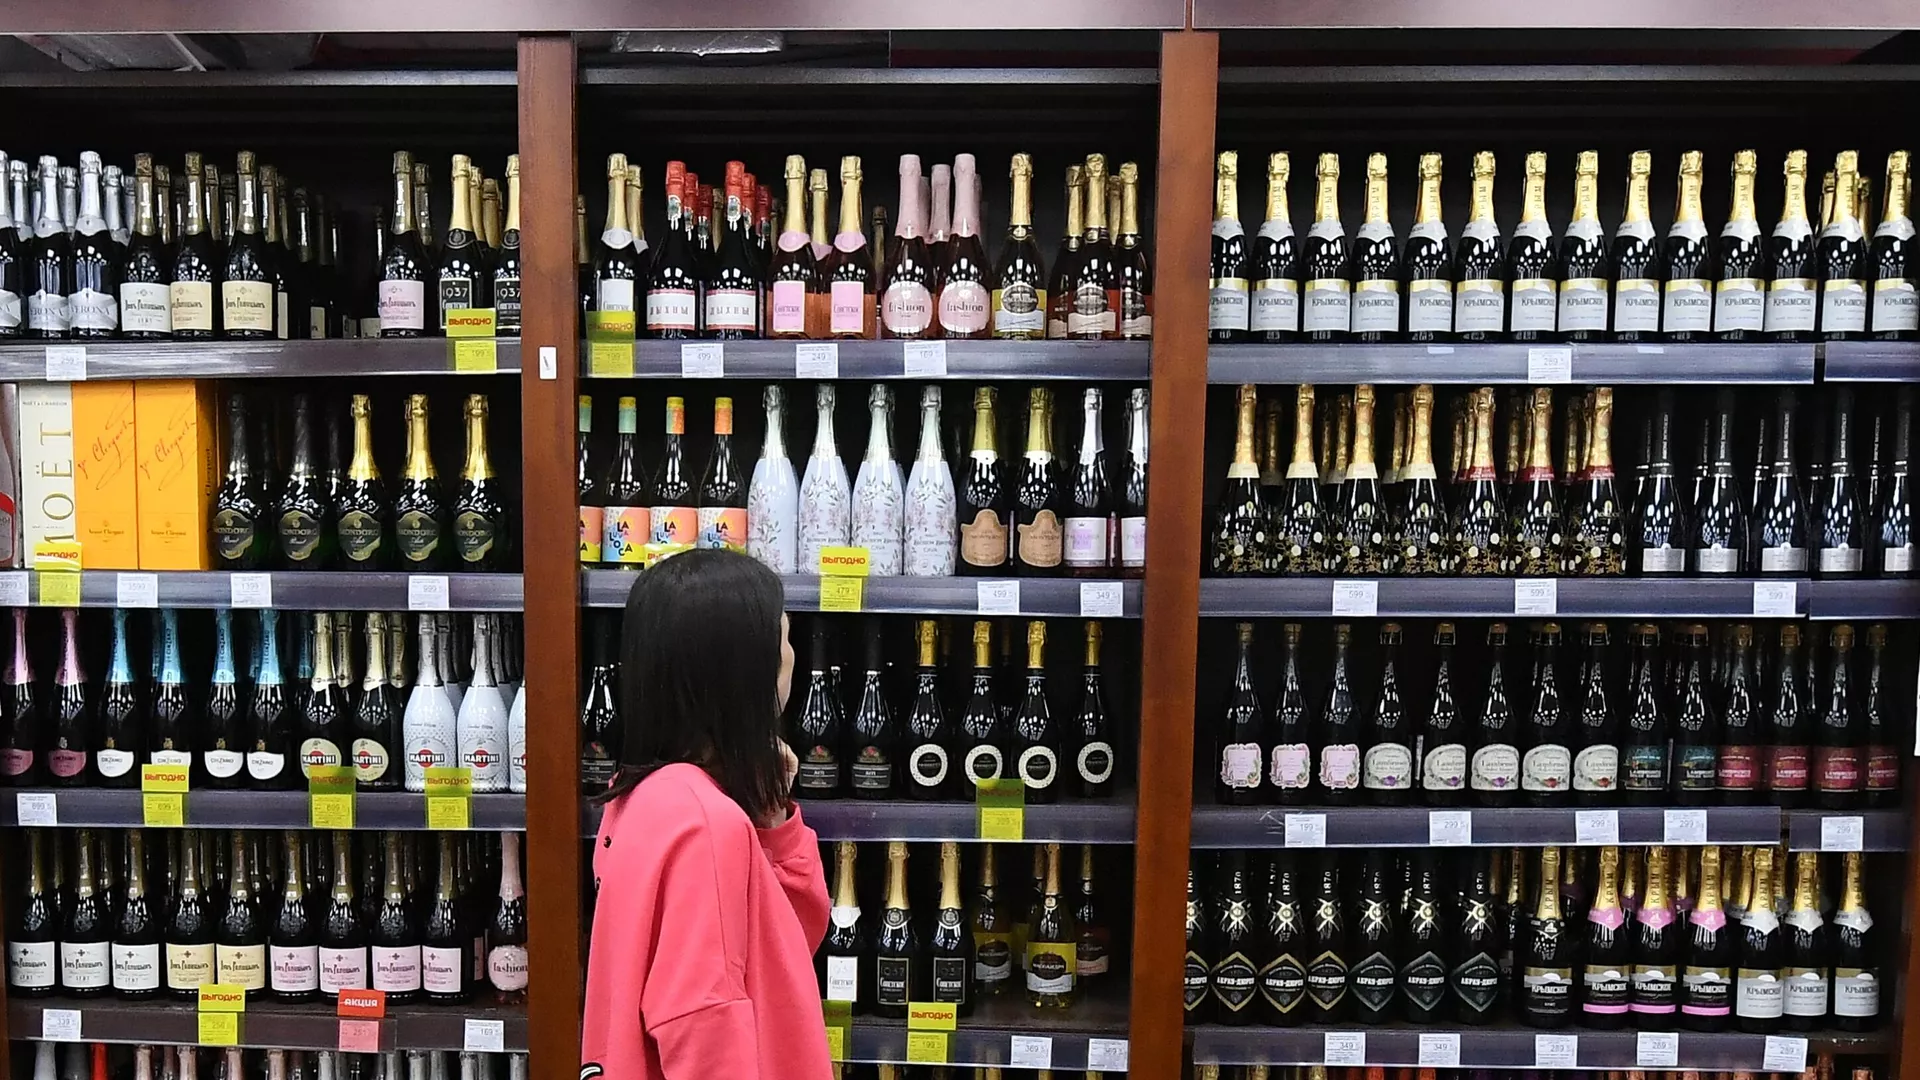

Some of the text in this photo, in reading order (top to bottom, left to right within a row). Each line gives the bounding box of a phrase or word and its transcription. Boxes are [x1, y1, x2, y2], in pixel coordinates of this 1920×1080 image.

[442, 287, 468, 298] 1937
[889, 302, 925, 312] fashion
[947, 301, 983, 312] fashion
[617, 521, 629, 532] LA
[664, 521, 676, 532] LA
[716, 522, 728, 533] LA
[409, 753, 445, 763] MARTINI
[464, 754, 500, 763] MARTINI
[1234, 871, 1242, 895] 1870
[1282, 872, 1291, 896] 1870
[1323, 871, 1331, 894] 1870
[1422, 871, 1431, 894] 1870
[1544, 879, 1553, 910] КРЫМ
[493, 962, 528, 972] fashion
